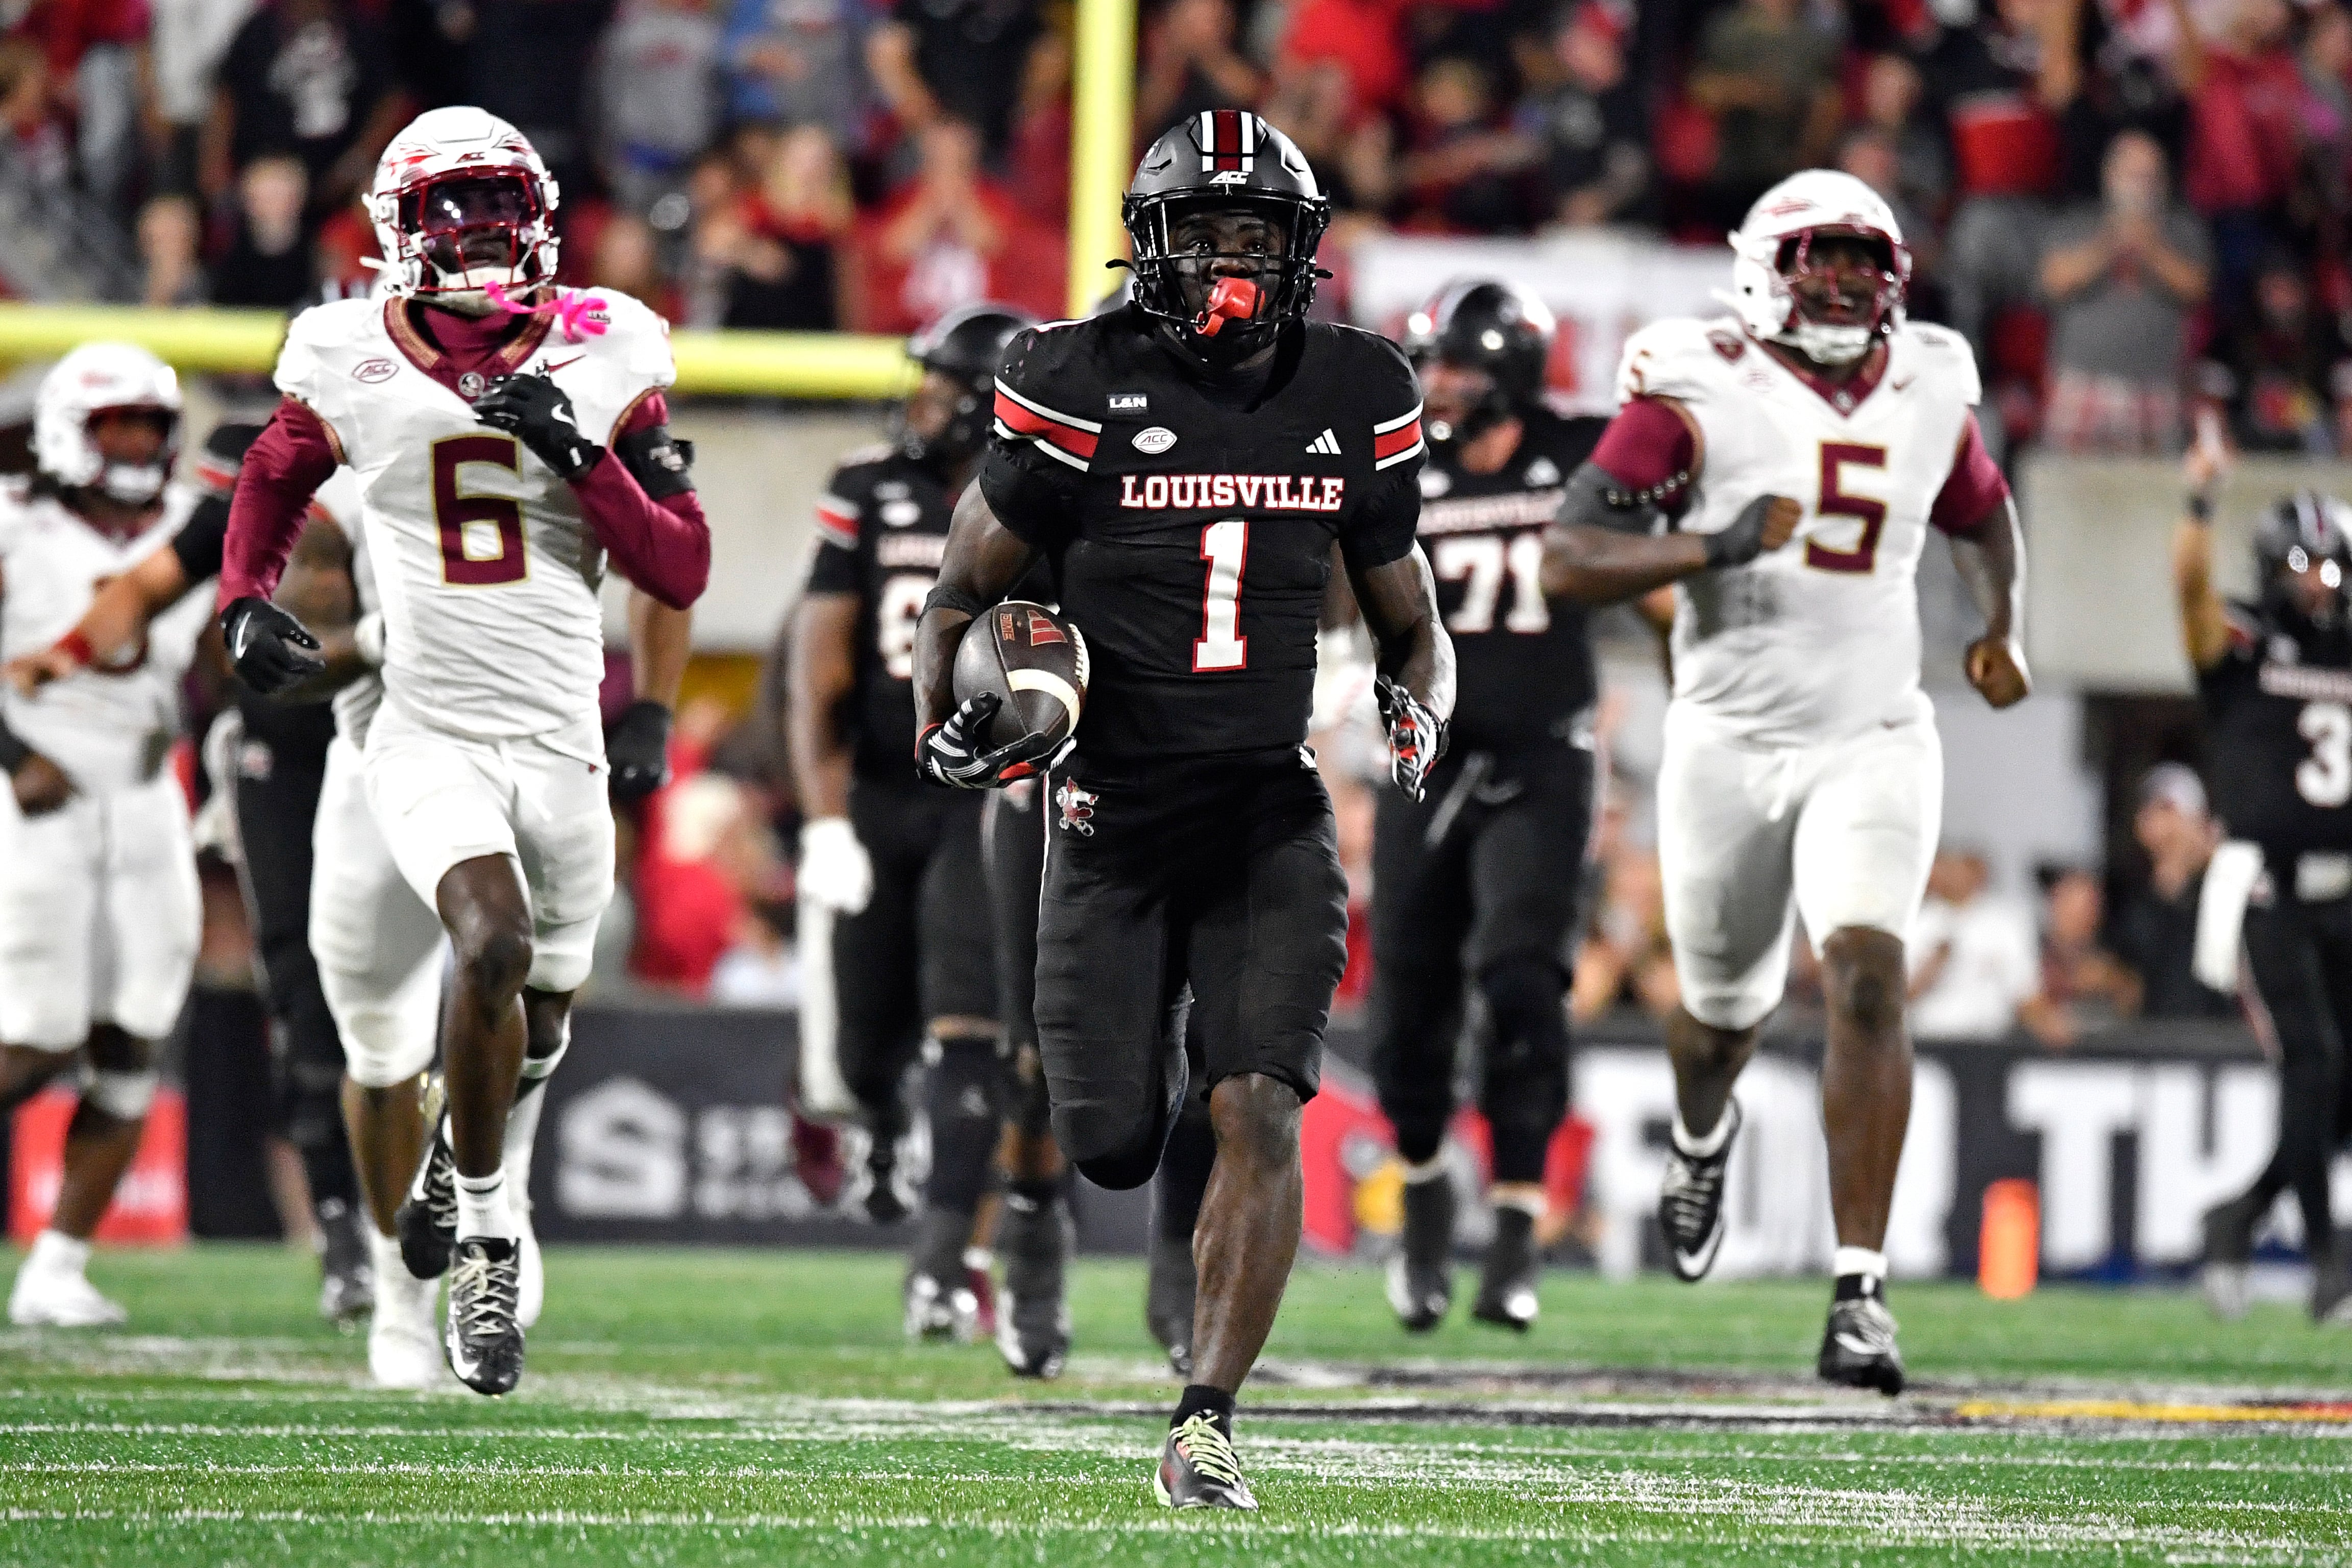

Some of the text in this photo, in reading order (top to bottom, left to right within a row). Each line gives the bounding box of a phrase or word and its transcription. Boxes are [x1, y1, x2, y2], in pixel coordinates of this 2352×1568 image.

[1209, 170, 1250, 185] ACC
[1109, 397, 1147, 408] L&N
[1138, 434, 1169, 447] ACC
[430, 434, 529, 587] 6
[1120, 474, 1344, 511] LOUISVILLE
[1804, 439, 1888, 575] 5
[1192, 518, 1250, 673] 1
[1433, 532, 1552, 635] 71
[1000, 613, 1015, 641] DIME
[2296, 702, 2352, 808] 3
